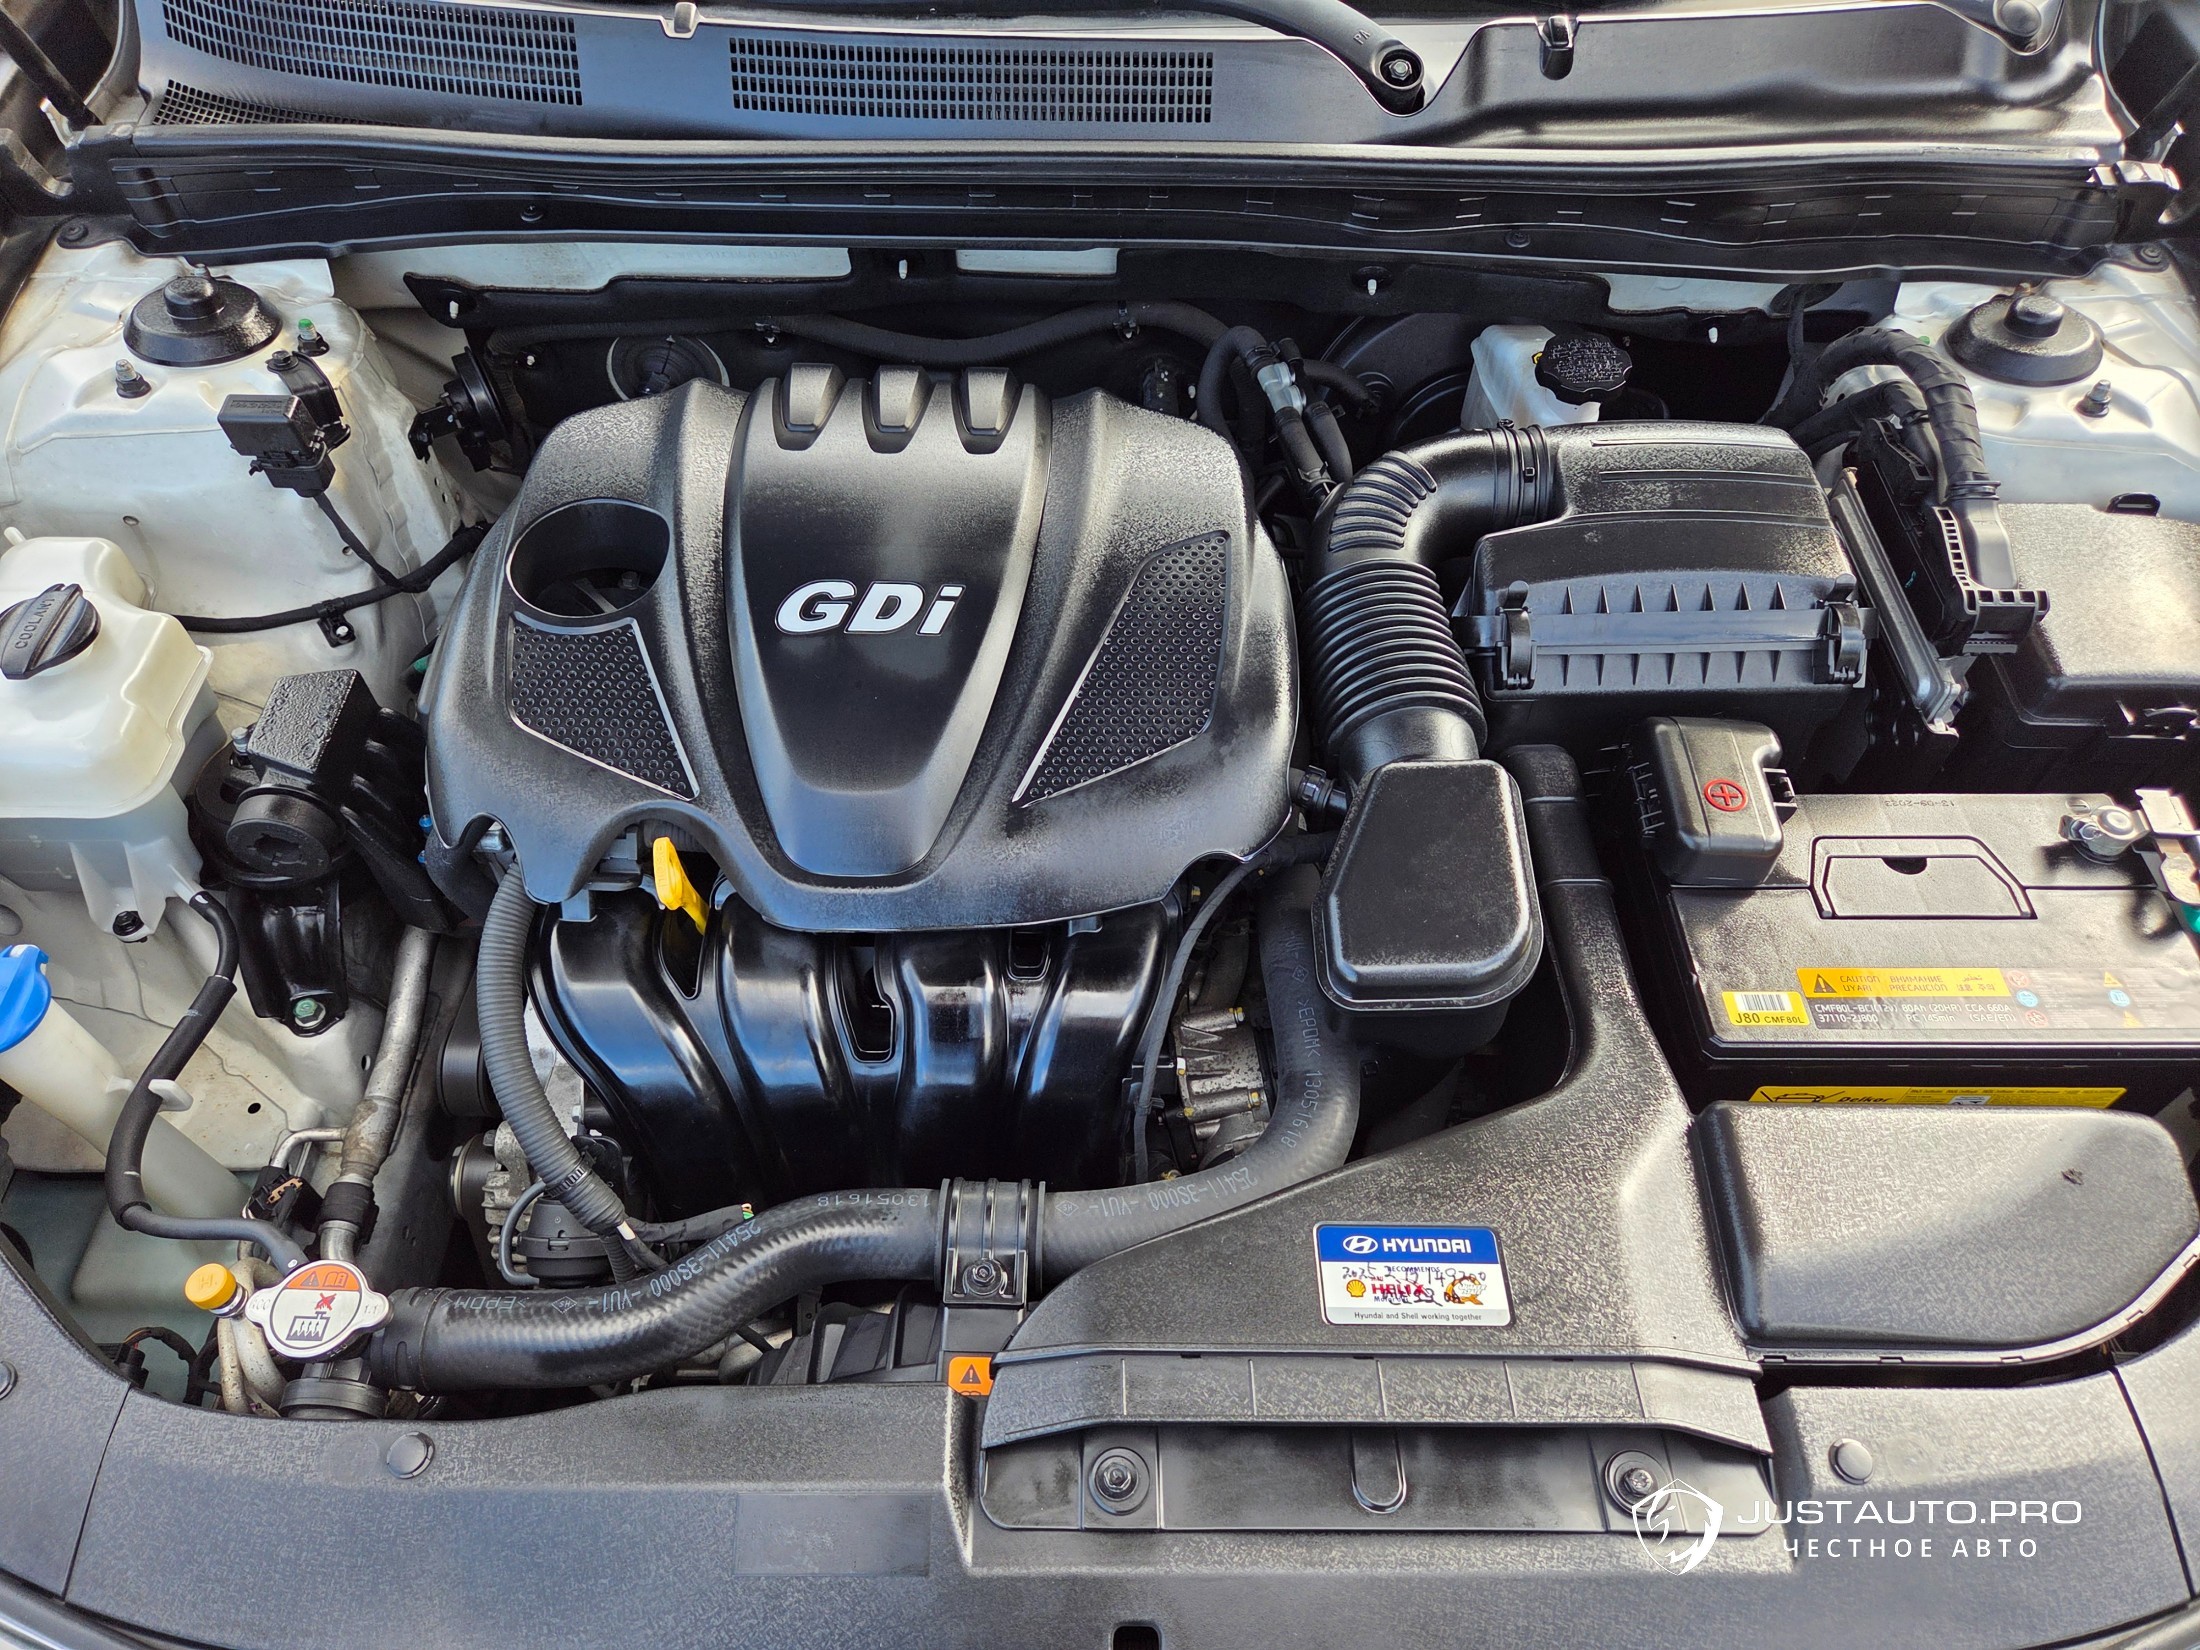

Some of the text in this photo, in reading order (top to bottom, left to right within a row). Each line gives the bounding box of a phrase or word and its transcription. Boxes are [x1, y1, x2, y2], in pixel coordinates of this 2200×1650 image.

[775, 580, 966, 636] GDi
[14, 598, 55, 650] COOLANT
[1890, 975, 1943, 983] ВНИМАНИЕ
[1843, 984, 1873, 992] UYARI
[1902, 1004, 1926, 1012] 80Ah
[1929, 1004, 1962, 1013] (20HR)
[1965, 1004, 1986, 1012] CCA
[1987, 1004, 2012, 1012] 660A
[1735, 1013, 1805, 1024] J80 CMF80L
[1923, 1014, 1955, 1022] 145min
[1281, 1070, 1323, 1149] 13051618
[1147, 1166, 1258, 1211] 25411-3S000
[817, 1193, 931, 1208] 13051618
[1382, 1238, 1472, 1253] HYUNDAI
[650, 1218, 762, 1298] 25411-3S000
[1354, 1311, 1384, 1320] Hyundai
[1401, 1312, 1419, 1320] Shell
[1421, 1312, 1450, 1321] working
[1451, 1313, 1482, 1322] together
